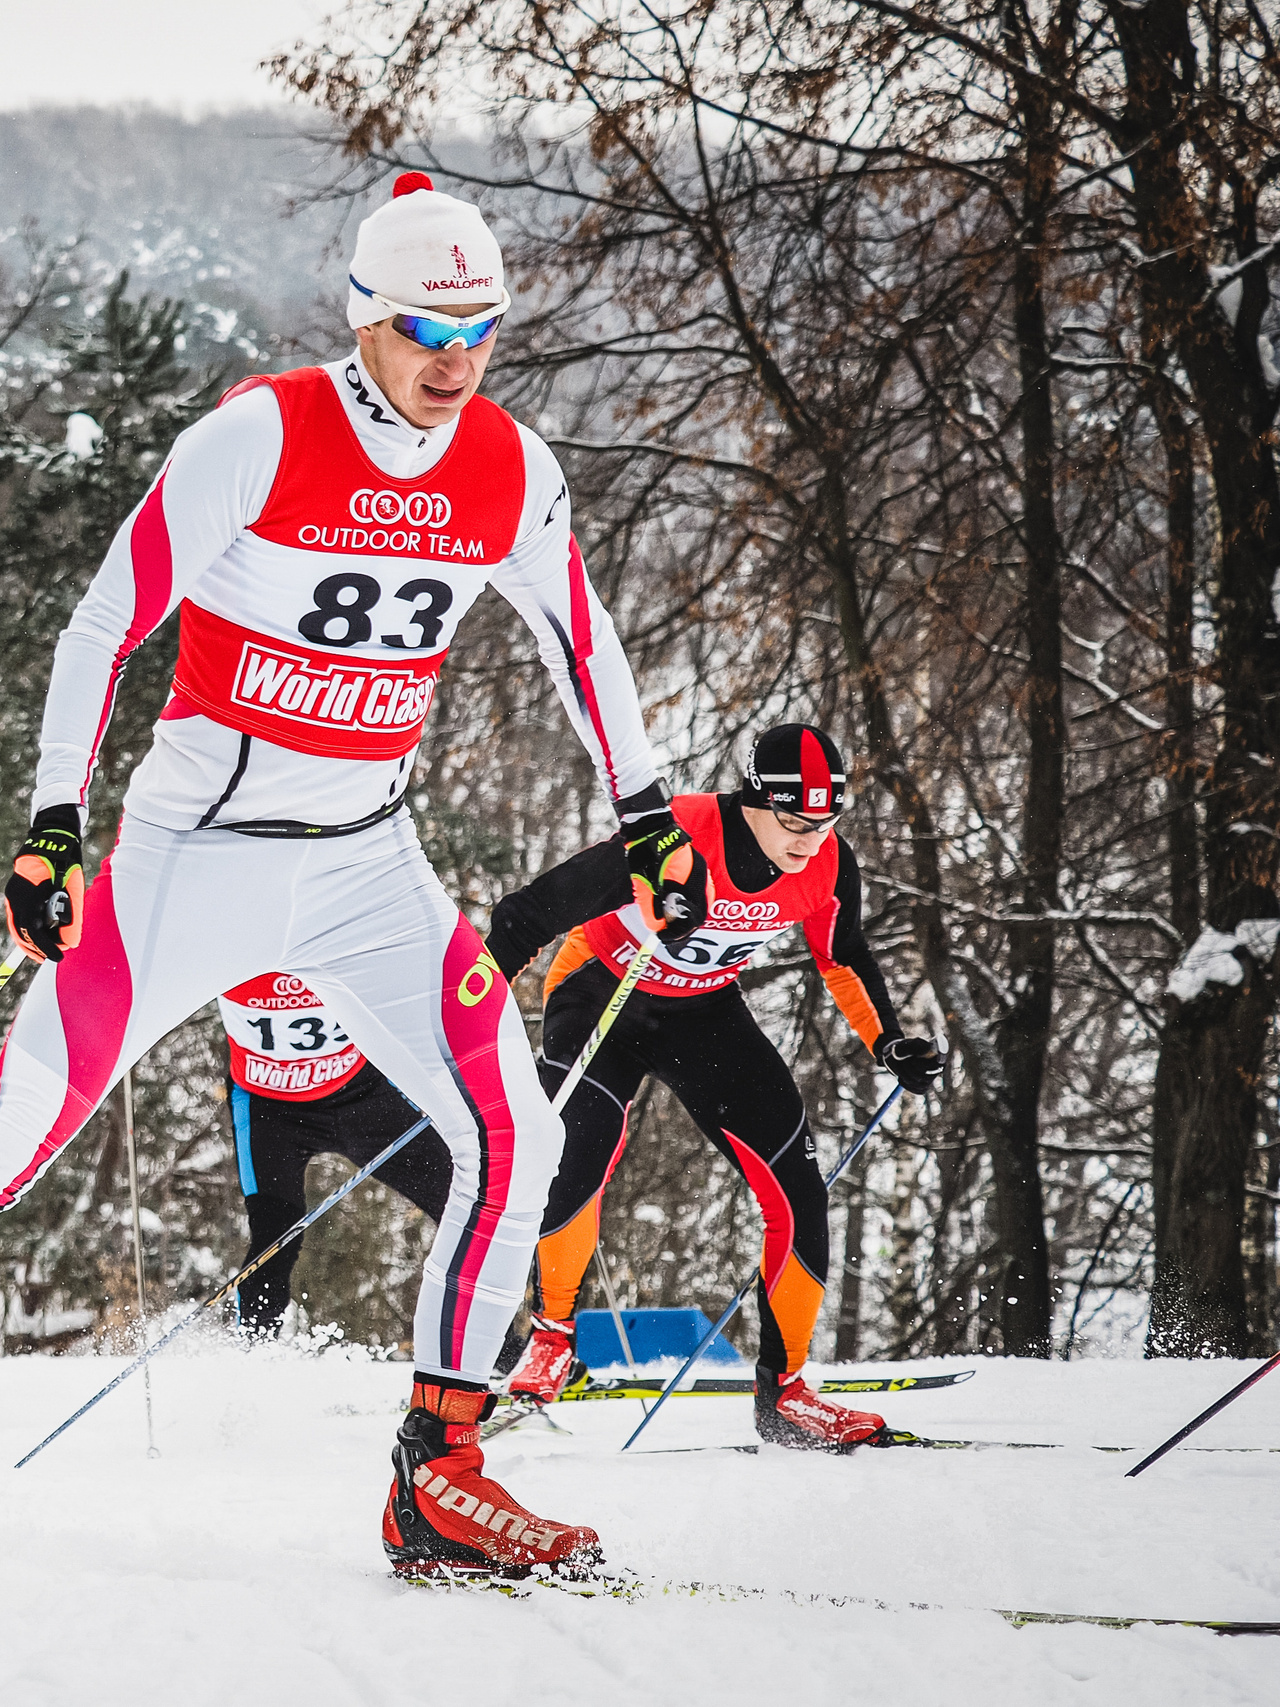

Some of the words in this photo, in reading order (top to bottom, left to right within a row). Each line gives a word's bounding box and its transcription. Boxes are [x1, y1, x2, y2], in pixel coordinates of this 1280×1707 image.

[421, 277, 493, 292] VASALOPPET
[298, 525, 420, 552] OUTDOOR
[428, 534, 485, 559] TEAM
[298, 572, 453, 648] 83
[241, 653, 365, 721] World
[755, 920, 795, 930] TEAM
[250, 1060, 311, 1089] World
[413, 1463, 565, 1552] alpina
